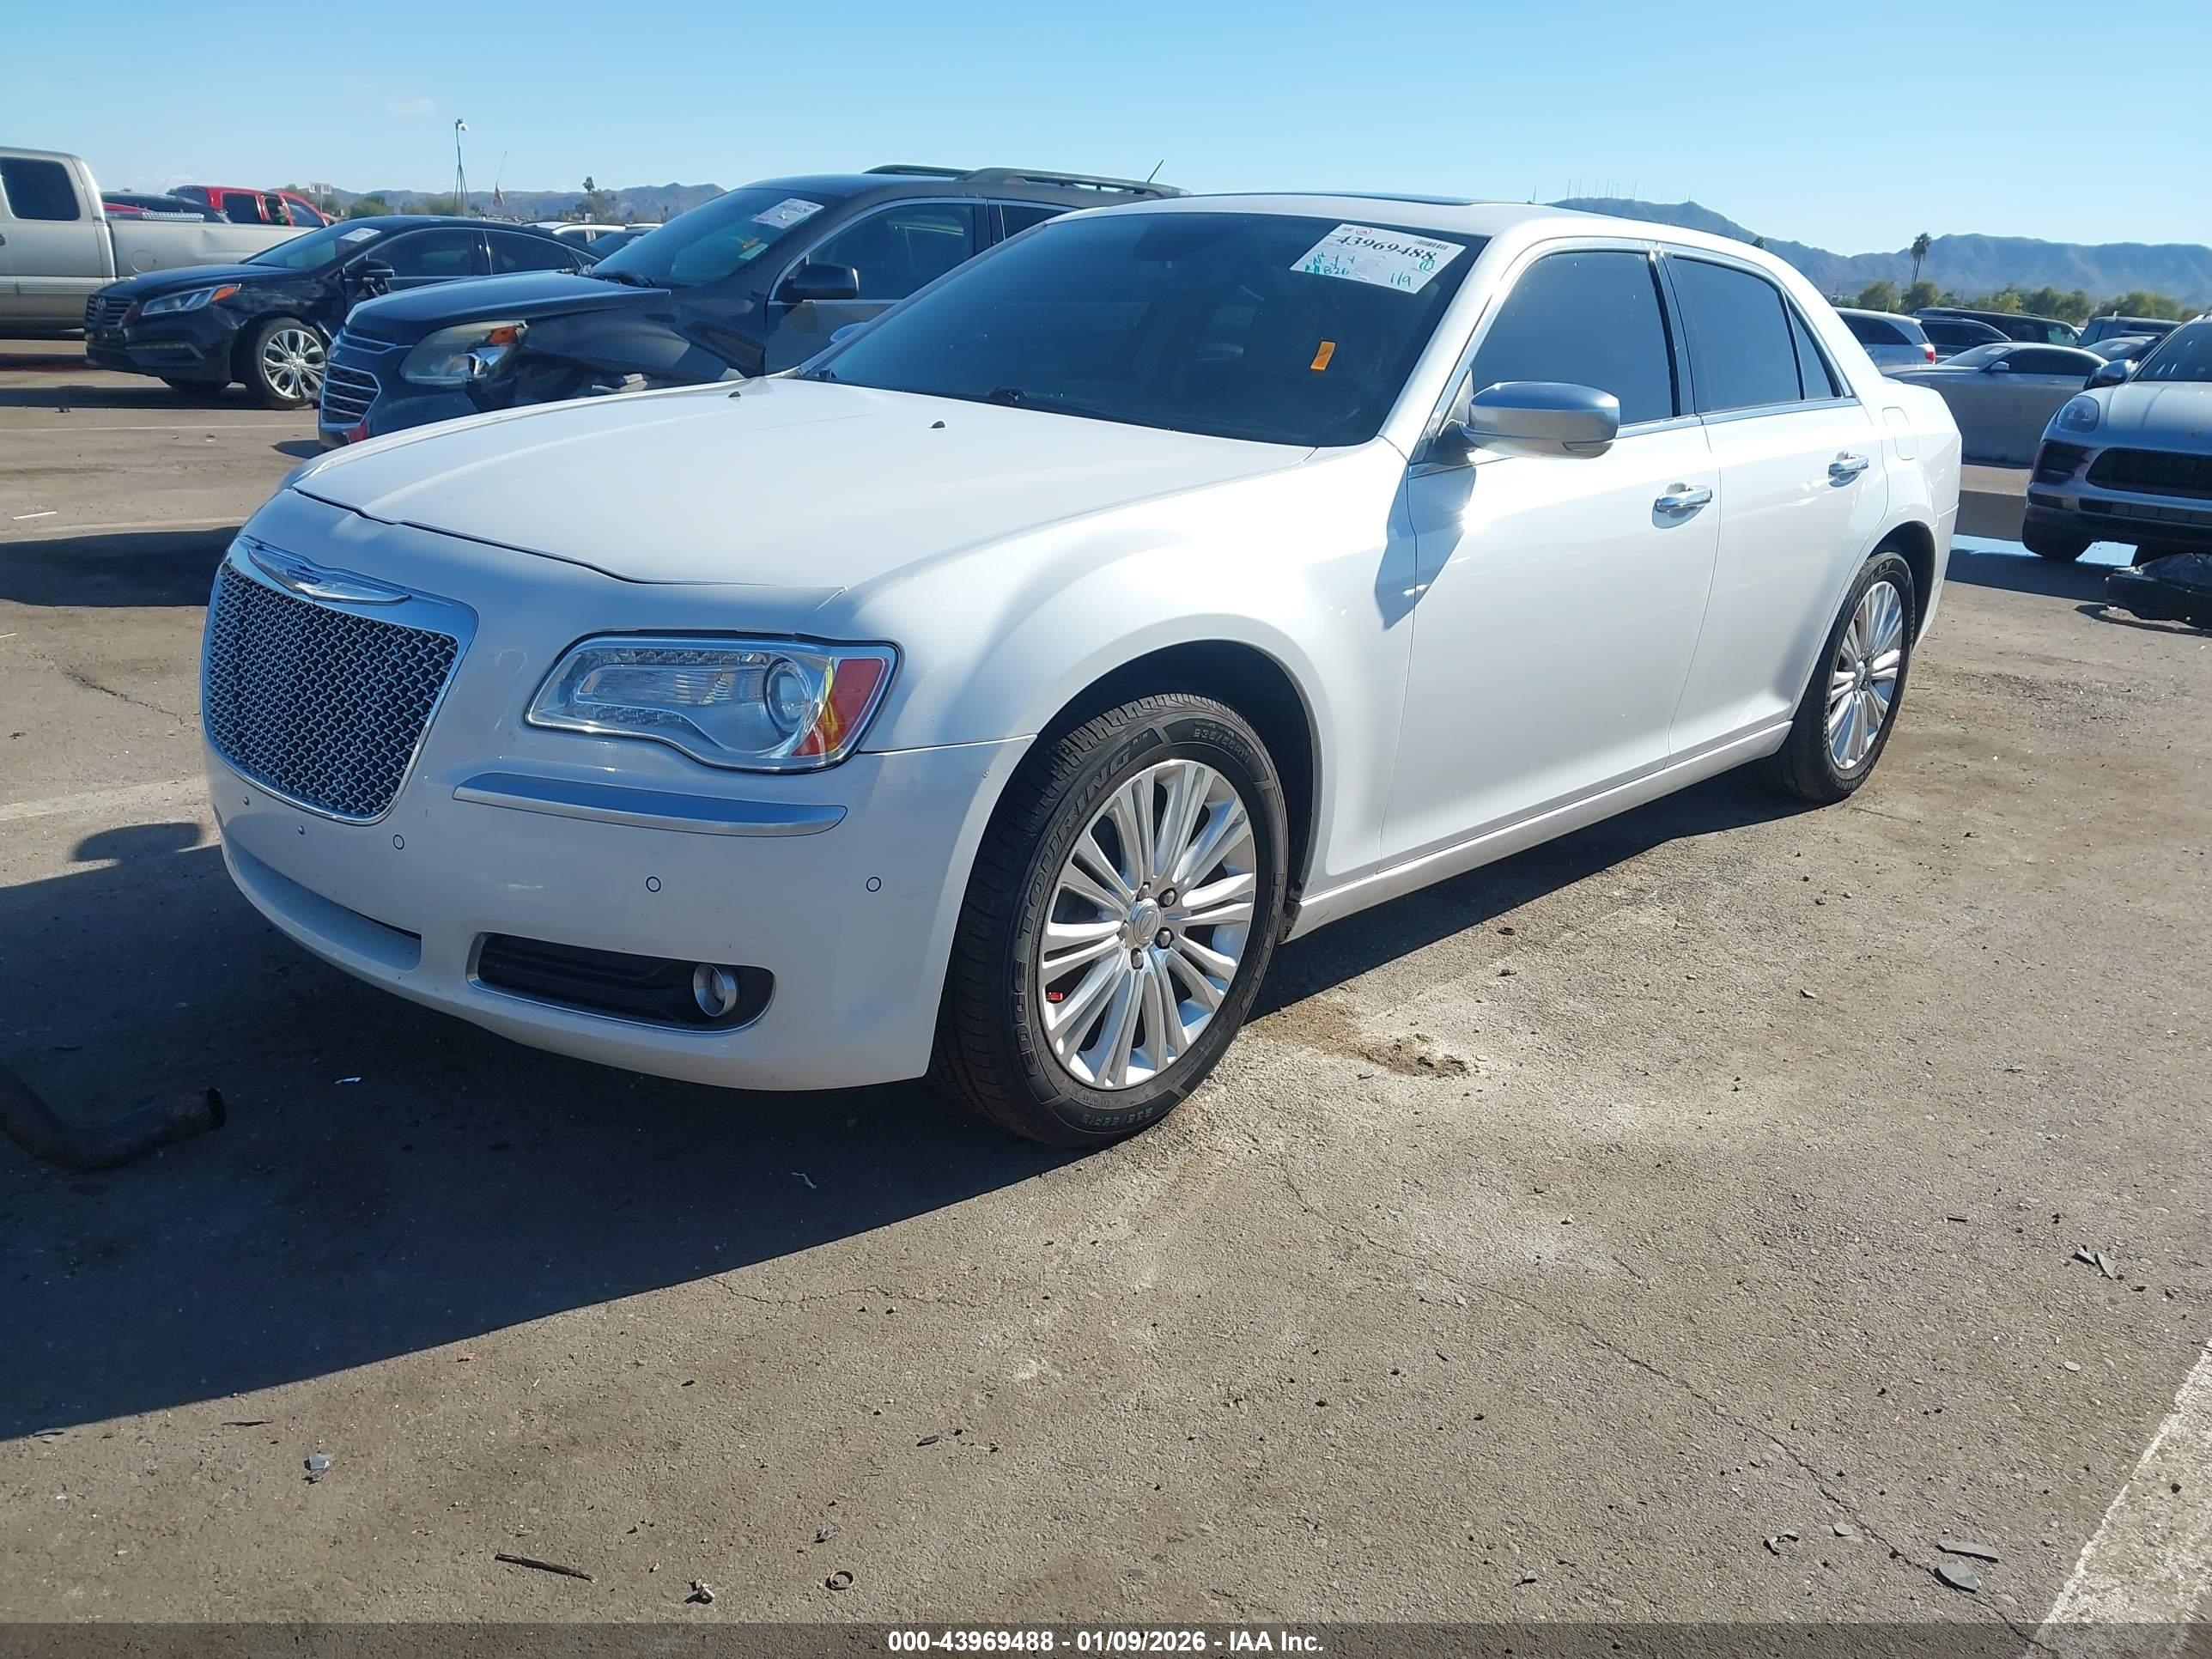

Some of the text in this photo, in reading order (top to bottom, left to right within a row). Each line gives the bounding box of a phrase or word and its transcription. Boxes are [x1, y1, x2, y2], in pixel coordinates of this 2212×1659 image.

[1336, 234, 1437, 261] 43969488
[1018, 748, 1132, 939] TOURING
[1014, 959, 1041, 1075] EDGE
